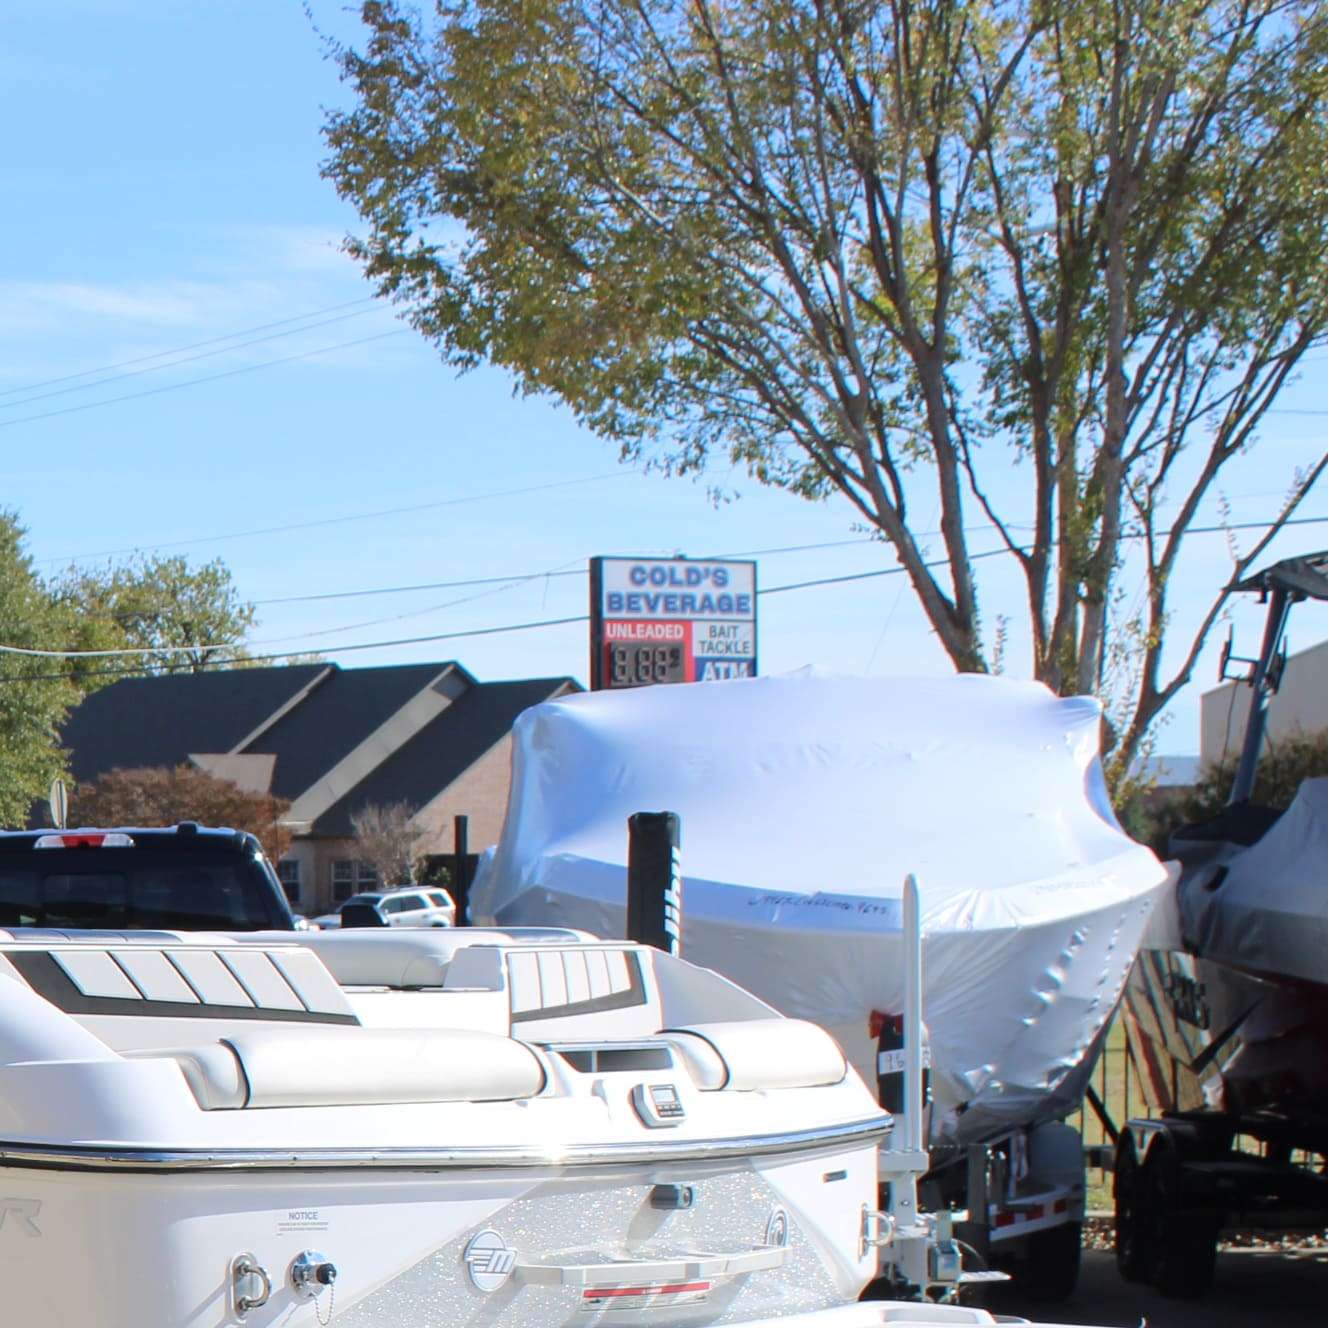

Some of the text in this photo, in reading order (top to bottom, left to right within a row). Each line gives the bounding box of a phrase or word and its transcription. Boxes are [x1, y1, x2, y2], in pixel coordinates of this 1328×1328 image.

[630, 566, 729, 588] COLD'S
[607, 592, 751, 613] BEVERAGE
[606, 623, 684, 639] UNLEADED
[709, 625, 740, 639] BAIT
[699, 641, 750, 654] TACKLE
[703, 661, 749, 682] ATM
[288, 1211, 319, 1220] NOTICE
